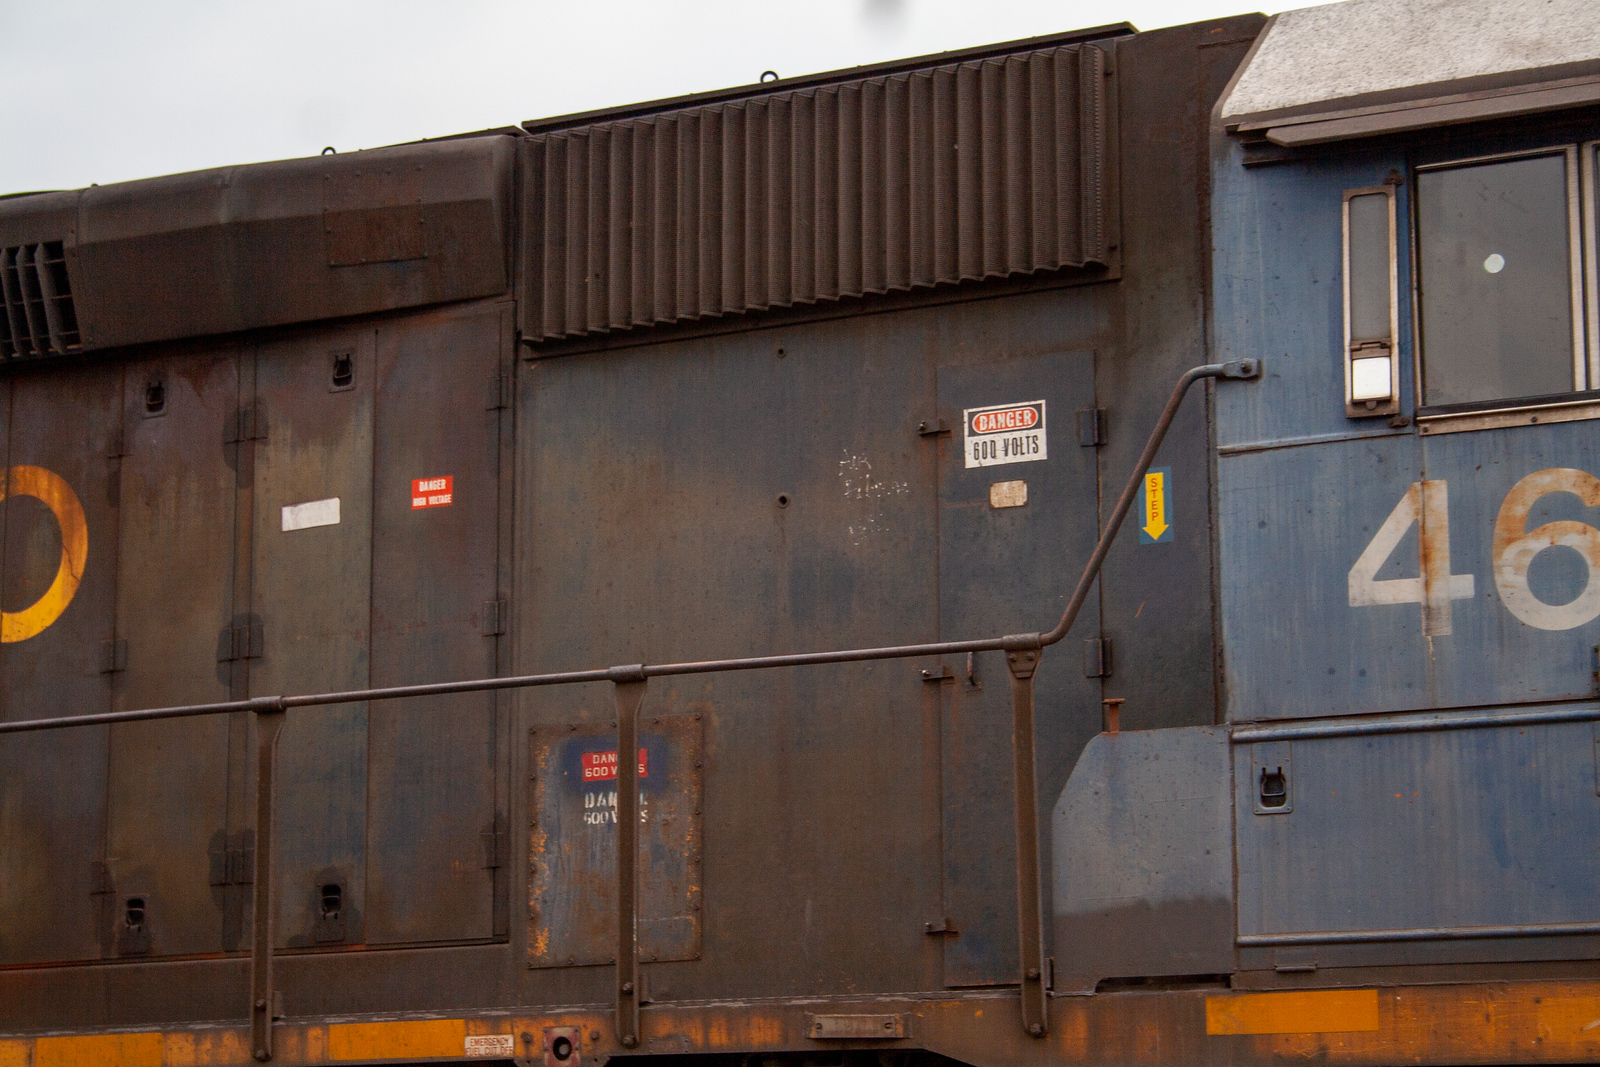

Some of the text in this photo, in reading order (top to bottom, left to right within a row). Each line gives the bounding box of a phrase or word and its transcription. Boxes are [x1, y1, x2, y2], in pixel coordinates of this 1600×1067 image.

[978, 409, 1032, 431] DANGER
[973, 434, 1039, 461] 600 VOLTS
[418, 478, 447, 492] DANGER
[1150, 477, 1159, 522] STEP
[584, 764, 609, 778] 600
[470, 1036, 509, 1047] EMERGENCY
